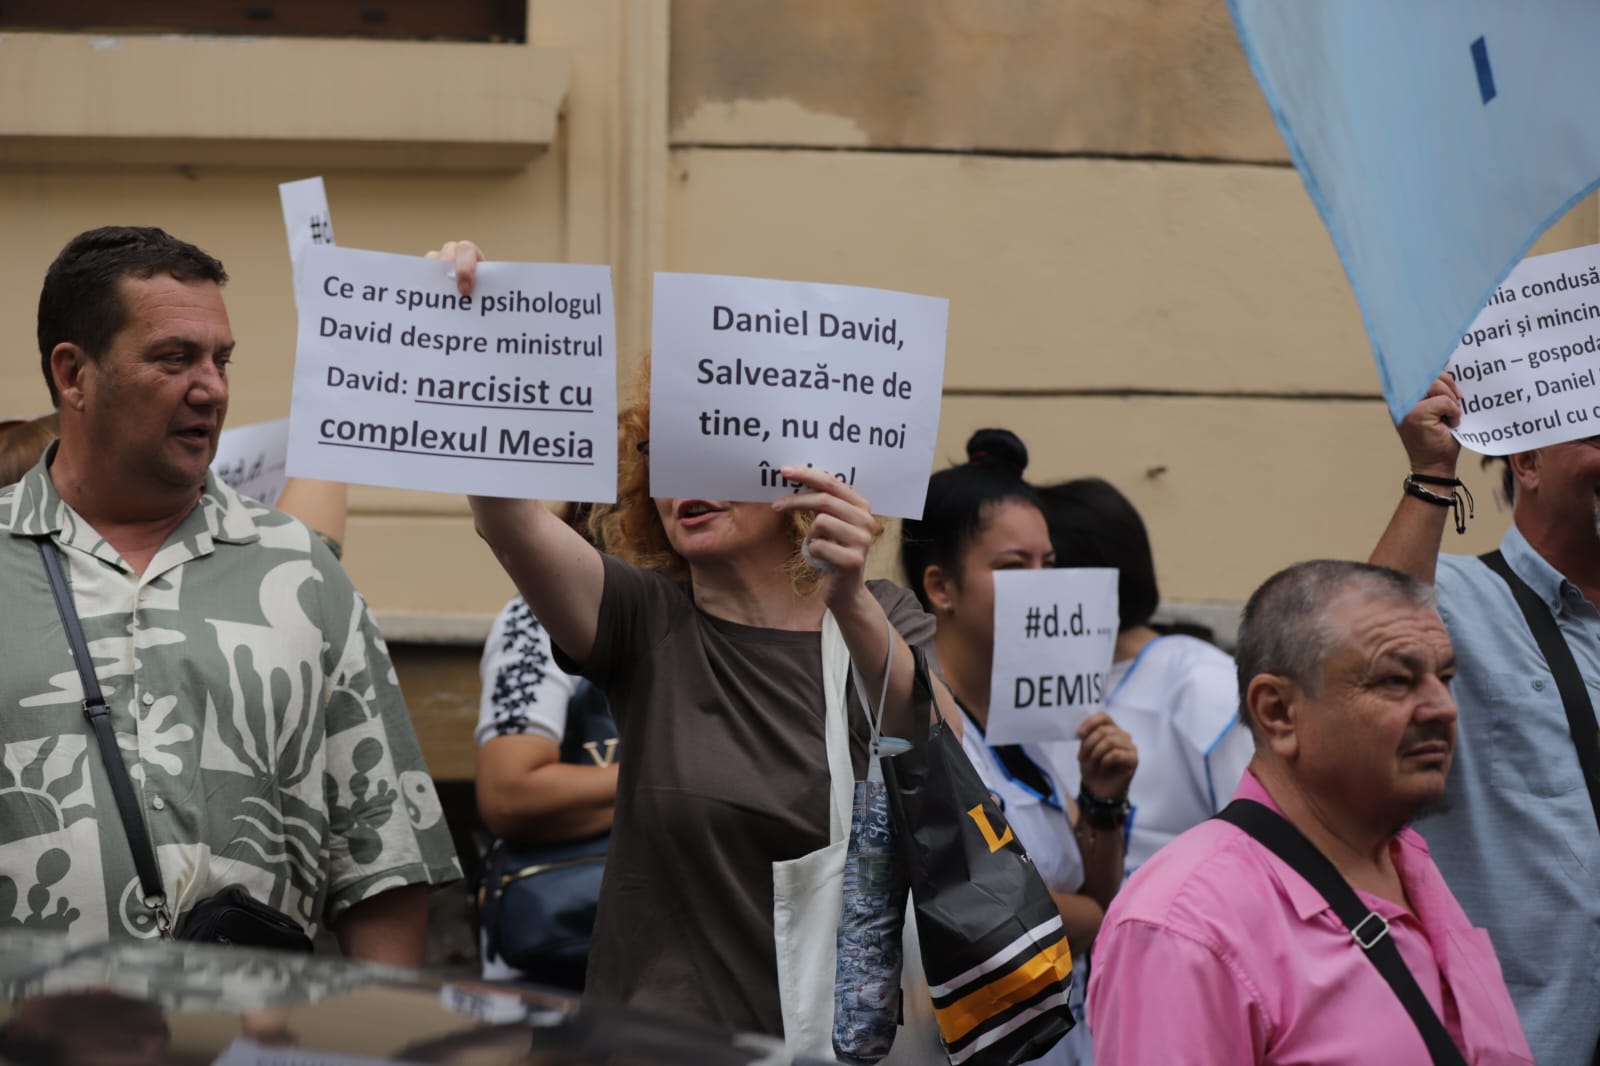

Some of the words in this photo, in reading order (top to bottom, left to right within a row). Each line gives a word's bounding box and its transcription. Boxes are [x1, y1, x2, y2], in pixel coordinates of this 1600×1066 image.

[323, 276, 354, 298] Ce
[362, 283, 388, 302] ar
[395, 288, 472, 311] spune
[480, 291, 601, 320] psihologul
[1484, 286, 1516, 307] nia
[1521, 266, 1600, 299] condusă
[319, 316, 392, 344] David
[400, 326, 488, 355] despre
[496, 333, 602, 357] ministrul
[713, 305, 808, 336] Daniel
[819, 313, 904, 351] David,
[1517, 314, 1531, 338] și
[1537, 303, 1600, 329] mincin
[326, 366, 408, 394] David:
[417, 375, 550, 405] narcisist
[559, 385, 593, 407] cu
[697, 358, 874, 395] Salvează-ne
[882, 372, 912, 400] de
[1535, 369, 1596, 397] Daniel
[699, 409, 770, 442] tine,
[782, 418, 818, 440] nu
[829, 415, 861, 444] de
[869, 424, 906, 449] noi
[1567, 408, 1588, 424] cu
[319, 418, 487, 453] complexul
[499, 429, 594, 459] Mesia
[1014, 672, 1103, 709] DEMIS
